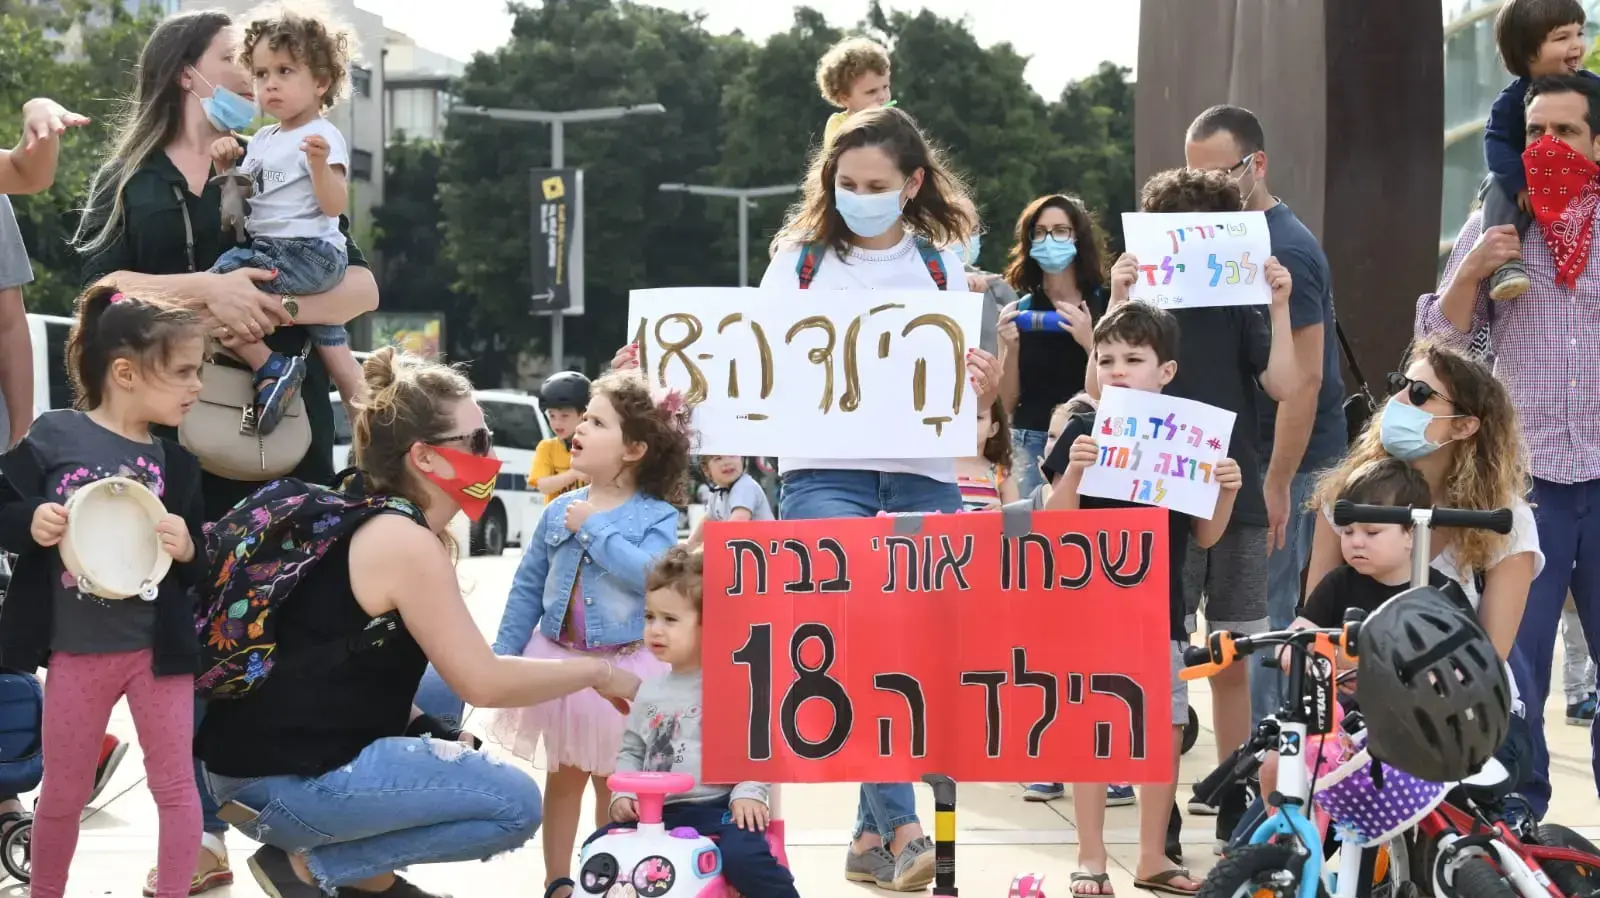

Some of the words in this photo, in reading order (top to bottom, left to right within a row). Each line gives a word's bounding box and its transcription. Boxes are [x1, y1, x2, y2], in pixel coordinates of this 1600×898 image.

[1140, 256, 1185, 286] ילד
[1208, 252, 1257, 287] לכל
[1154, 453, 1212, 483] רוצה
[1130, 479, 1167, 503] לגן
[725, 537, 852, 596] בבית
[1000, 530, 1154, 591] שכחו
[960, 647, 1147, 760] הילד
